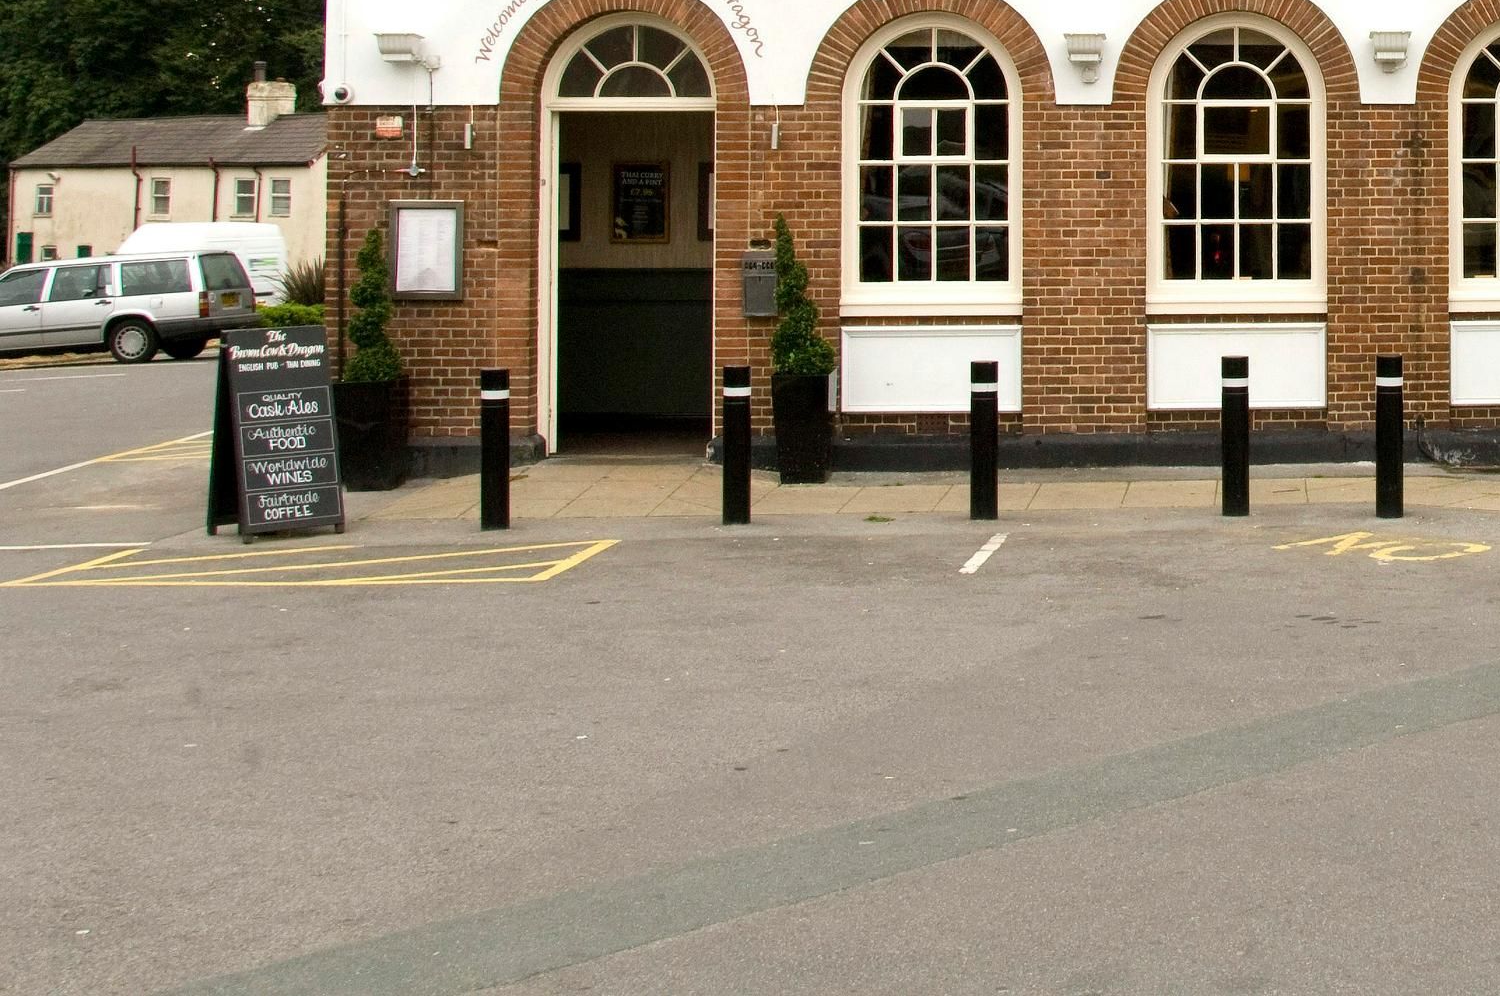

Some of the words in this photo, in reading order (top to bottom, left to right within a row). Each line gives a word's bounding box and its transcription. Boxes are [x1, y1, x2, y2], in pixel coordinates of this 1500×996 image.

[266, 330, 287, 343] The
[230, 345, 260, 359] Brown
[260, 344, 278, 358] Cow
[287, 342, 324, 358] Dragon
[238, 363, 264, 372] ENGLISH
[266, 362, 279, 370] PUB
[286, 360, 299, 369] THAI
[300, 359, 321, 368] DINING
[262, 392, 302, 402] QUALITY
[247, 402, 284, 418] Cask
[284, 399, 319, 415] Ales
[248, 424, 316, 441] Authentic
[269, 437, 306, 451] FOOD
[248, 457, 328, 474] Worldwide
[267, 470, 313, 485] WINES
[258, 491, 320, 508] Fairtrade
[264, 505, 313, 520] COFFEE
[1271, 531, 1492, 562] NO
